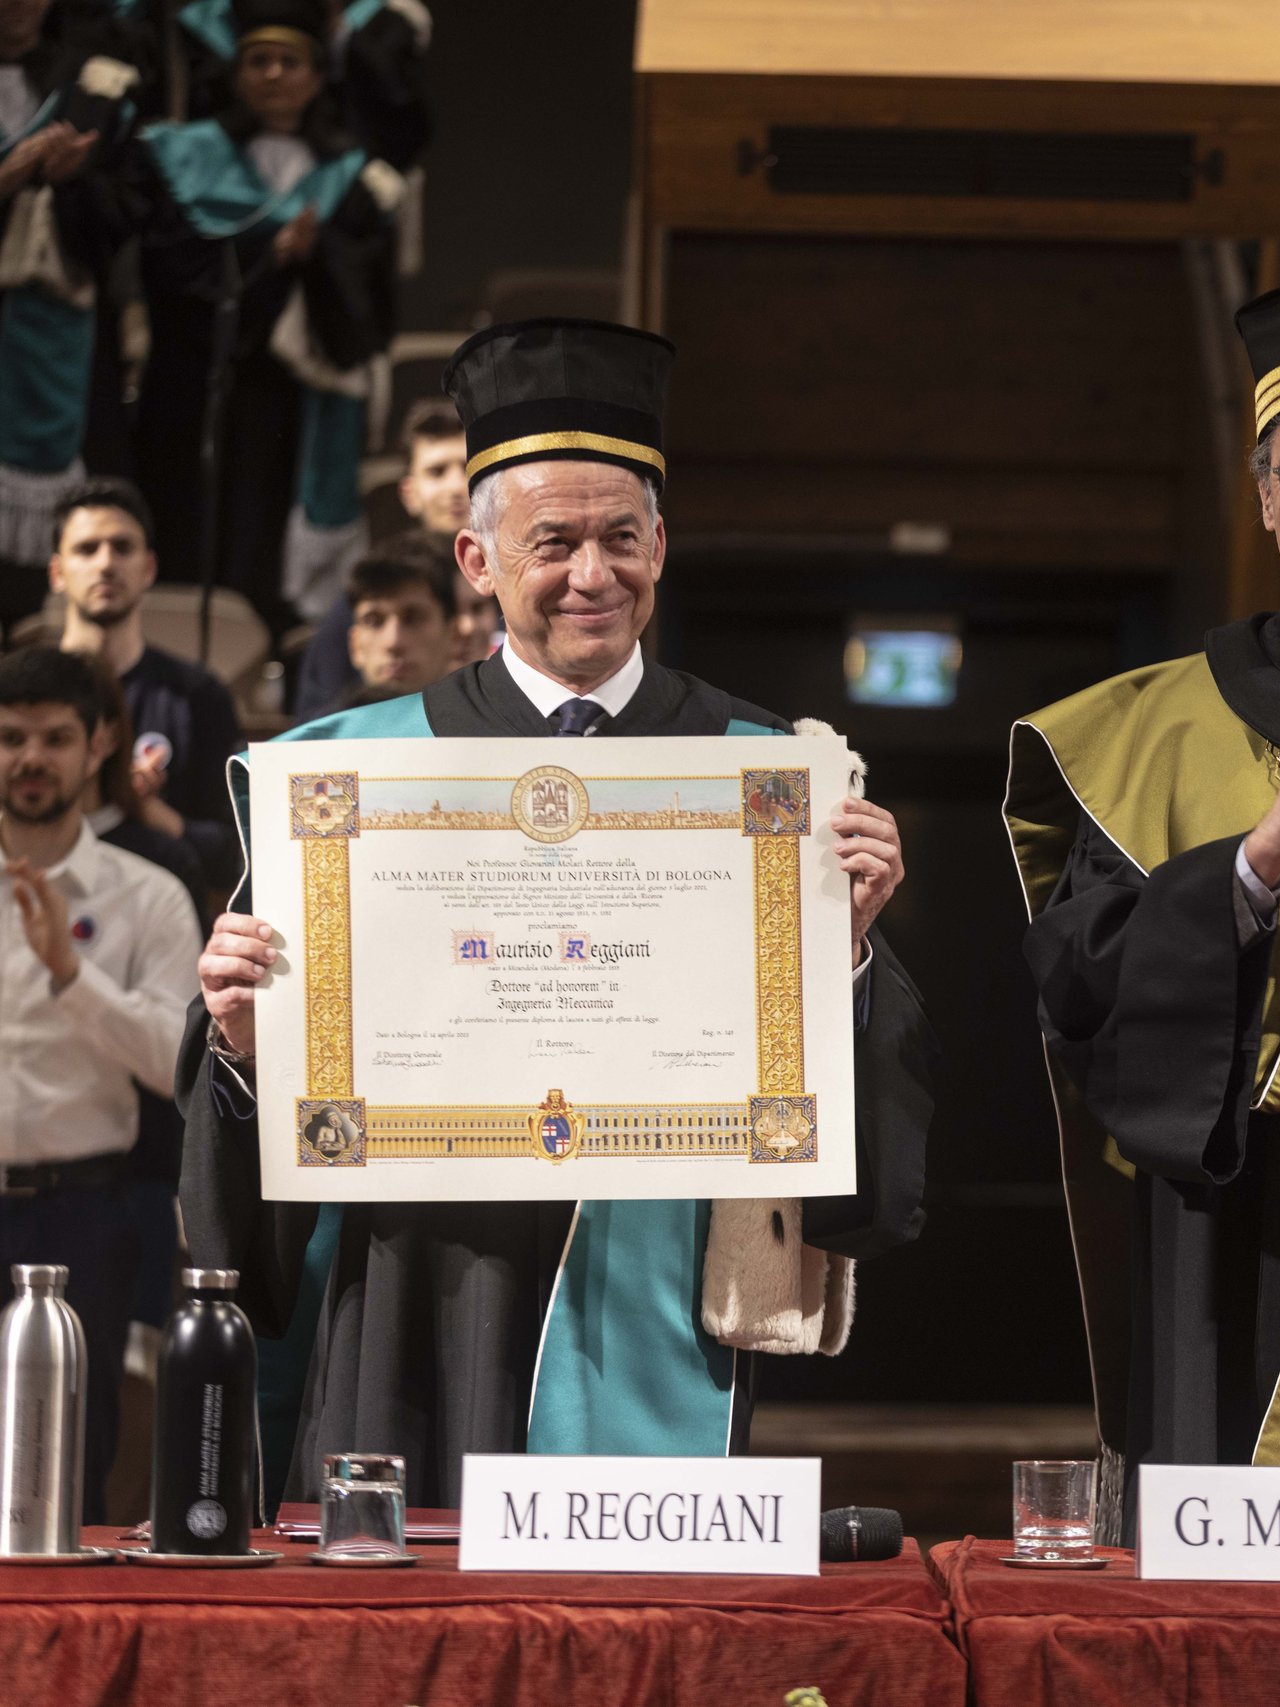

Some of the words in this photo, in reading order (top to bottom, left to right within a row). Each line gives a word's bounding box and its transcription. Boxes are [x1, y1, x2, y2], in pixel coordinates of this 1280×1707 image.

[616, 858, 636, 867] della
[370, 871, 412, 882] ALMA
[417, 871, 465, 882] MATER
[470, 871, 552, 882] STUDIORUM
[558, 868, 641, 882] UNIVERSITÀ
[646, 870, 660, 881] DI
[666, 870, 732, 881] BOLOGNA
[528, 922, 578, 932] proclamiamo
[459, 938, 553, 960] Maurizio
[566, 938, 650, 963] Reggiani
[486, 980, 531, 994] Dottore
[609, 982, 619, 992] in
[497, 997, 552, 1012] Ingegneria
[556, 996, 614, 1010] Meccanica
[536, 1038, 543, 1048] Il
[546, 1040, 574, 1048] Rettore
[696, 1050, 736, 1058] Dipartimento
[502, 1491, 549, 1541] M.
[564, 1492, 784, 1542] REGGIANI
[1174, 1496, 1224, 1547] G.
